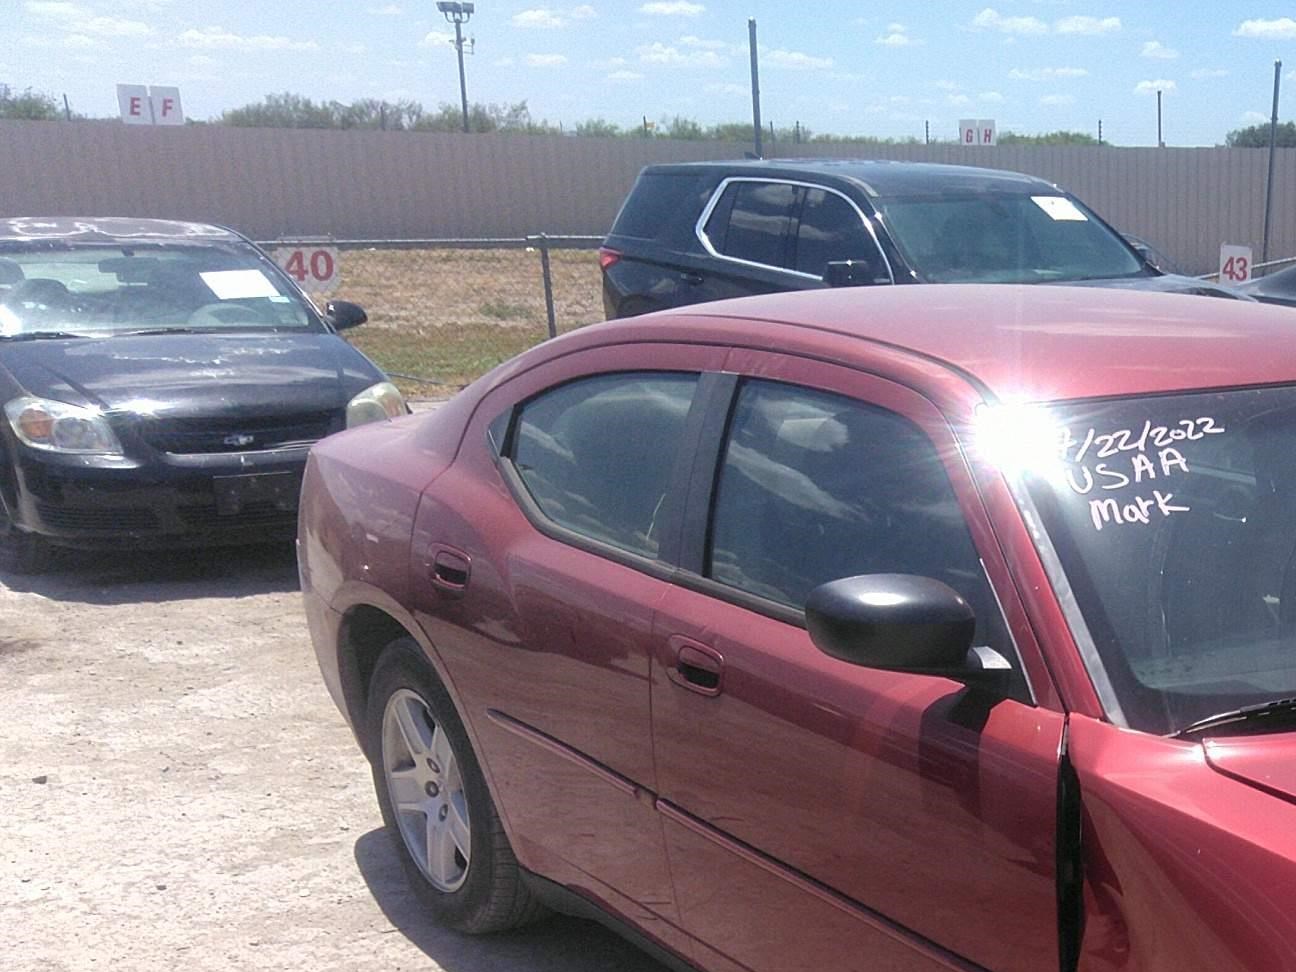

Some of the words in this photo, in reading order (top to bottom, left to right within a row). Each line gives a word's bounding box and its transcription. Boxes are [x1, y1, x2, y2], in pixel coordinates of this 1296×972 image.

[130, 96, 141, 116] E
[162, 98, 174, 117] F
[965, 128, 974, 143] G
[983, 128, 992, 143] H
[285, 249, 334, 282] 40
[1222, 256, 1248, 282] 43
[1068, 447, 1190, 494] USAA
[1088, 490, 1190, 530] Mark
